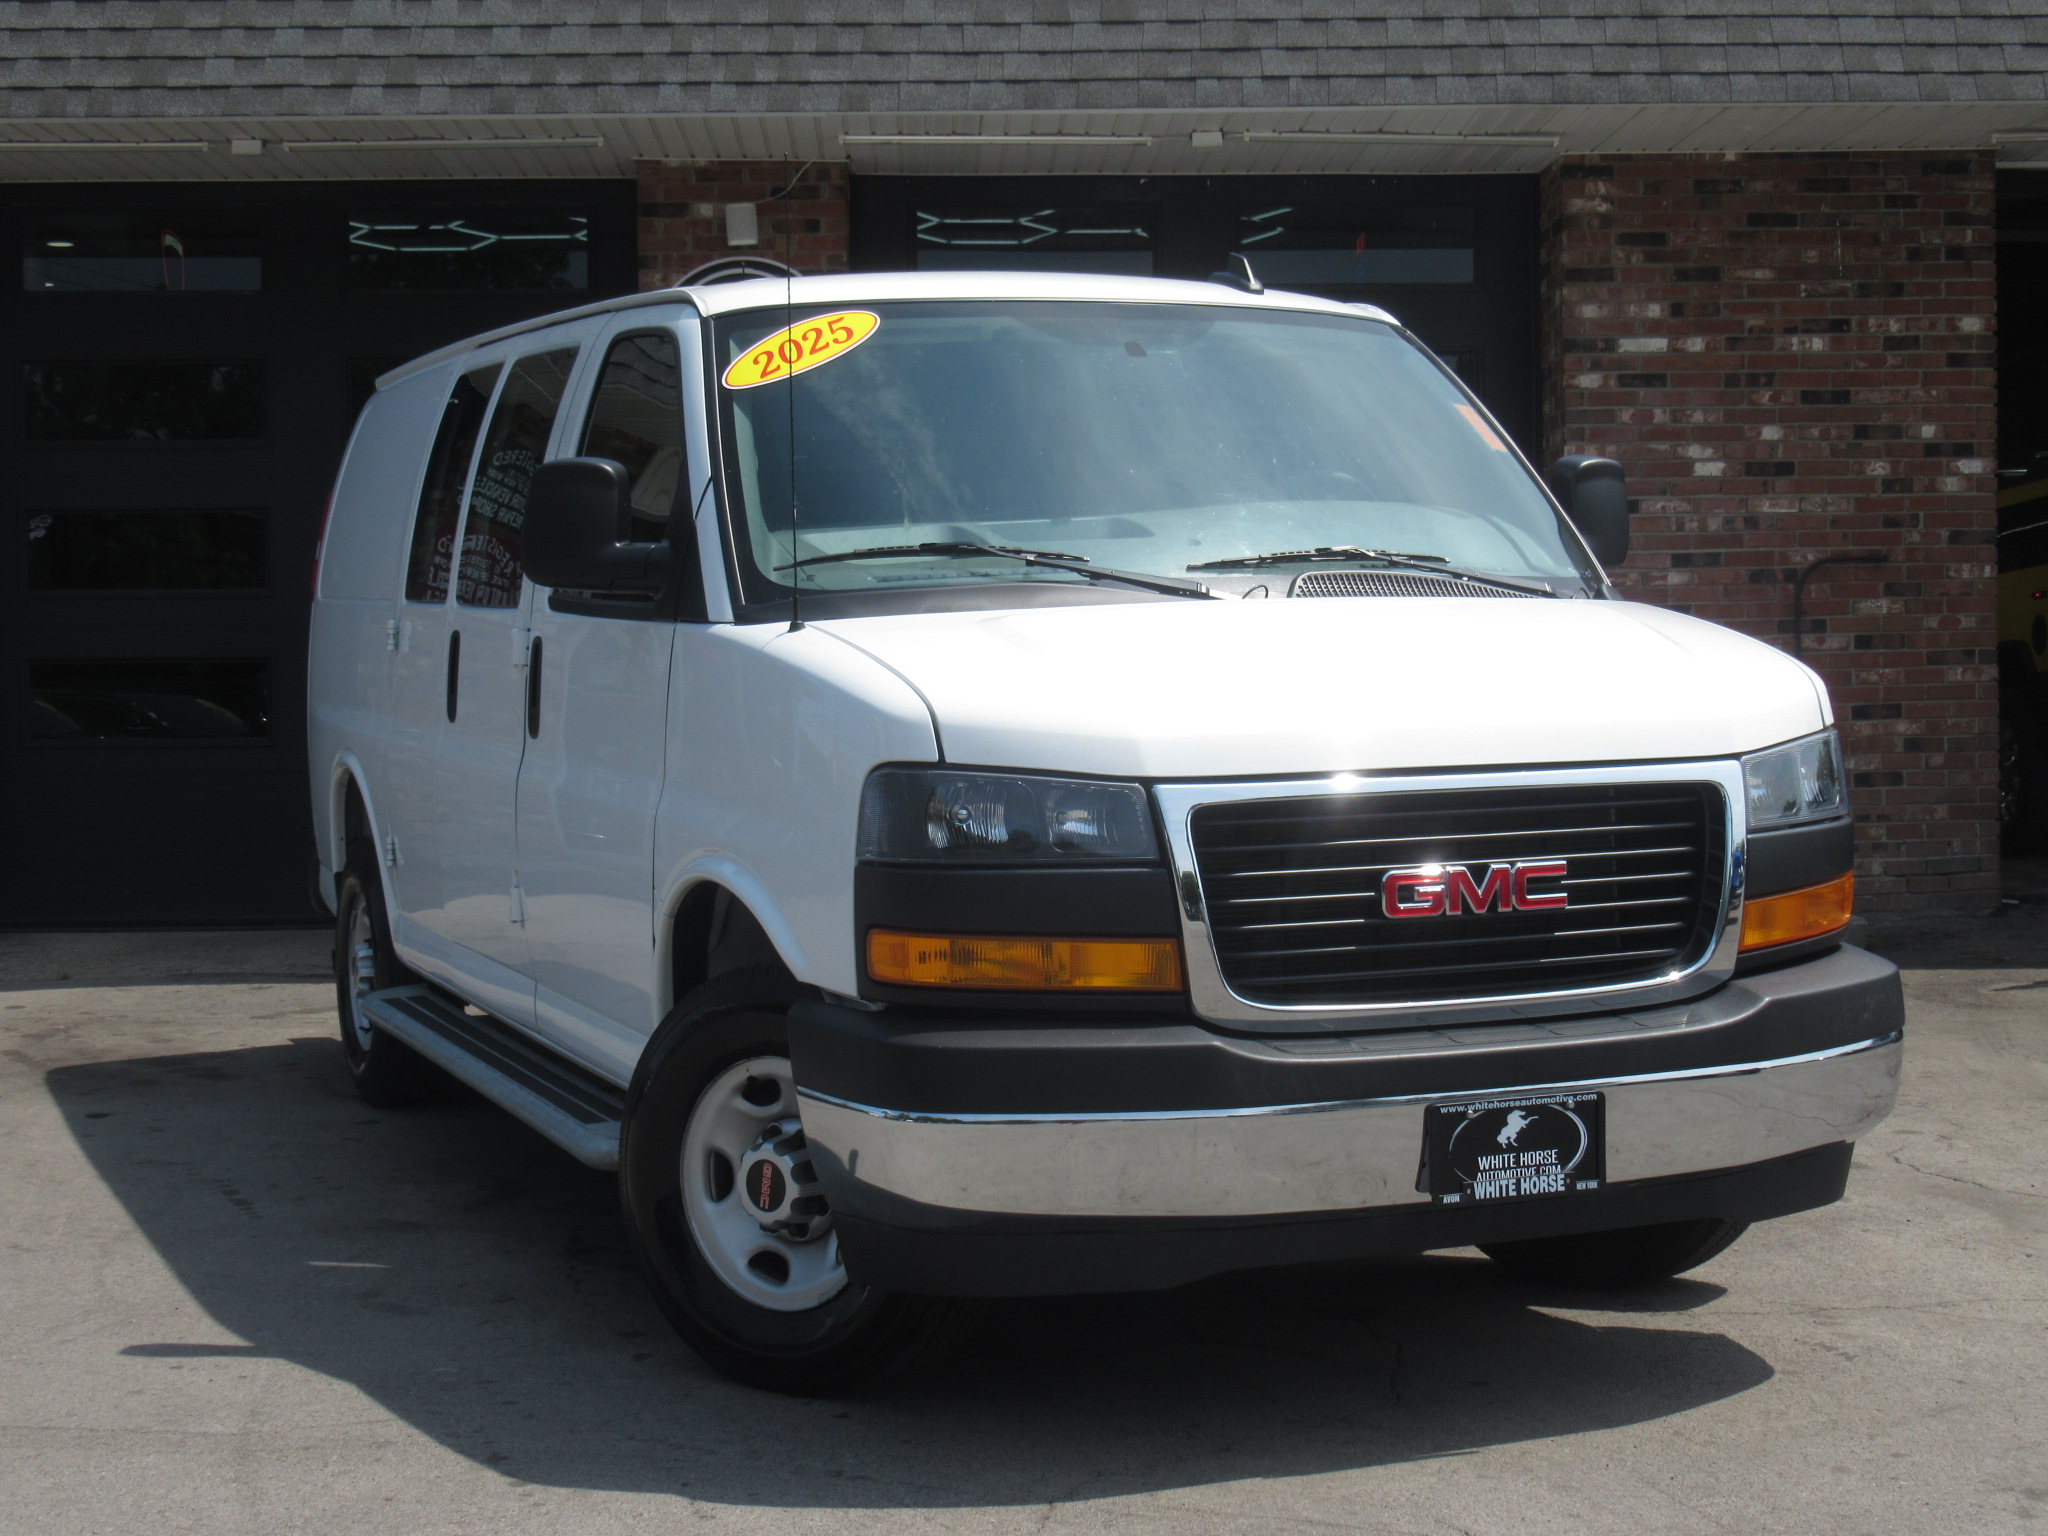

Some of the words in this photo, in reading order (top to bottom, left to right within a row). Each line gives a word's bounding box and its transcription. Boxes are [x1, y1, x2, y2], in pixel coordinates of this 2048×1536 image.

[752, 316, 854, 379] 2025
[1382, 860, 1568, 919] GMC
[1440, 1093, 1597, 1113] www.whitehorseautomotive.com
[1478, 1153, 1517, 1170] WHITE
[1520, 1149, 1559, 1166] HORSE
[760, 1163, 773, 1210] GMC
[1474, 1178, 1517, 1200] WHITE
[1520, 1173, 1565, 1195] HORSE
[1577, 1182, 1586, 1190] NEW
[1587, 1180, 1598, 1189] YORK
[1443, 1194, 1460, 1204] AVON
